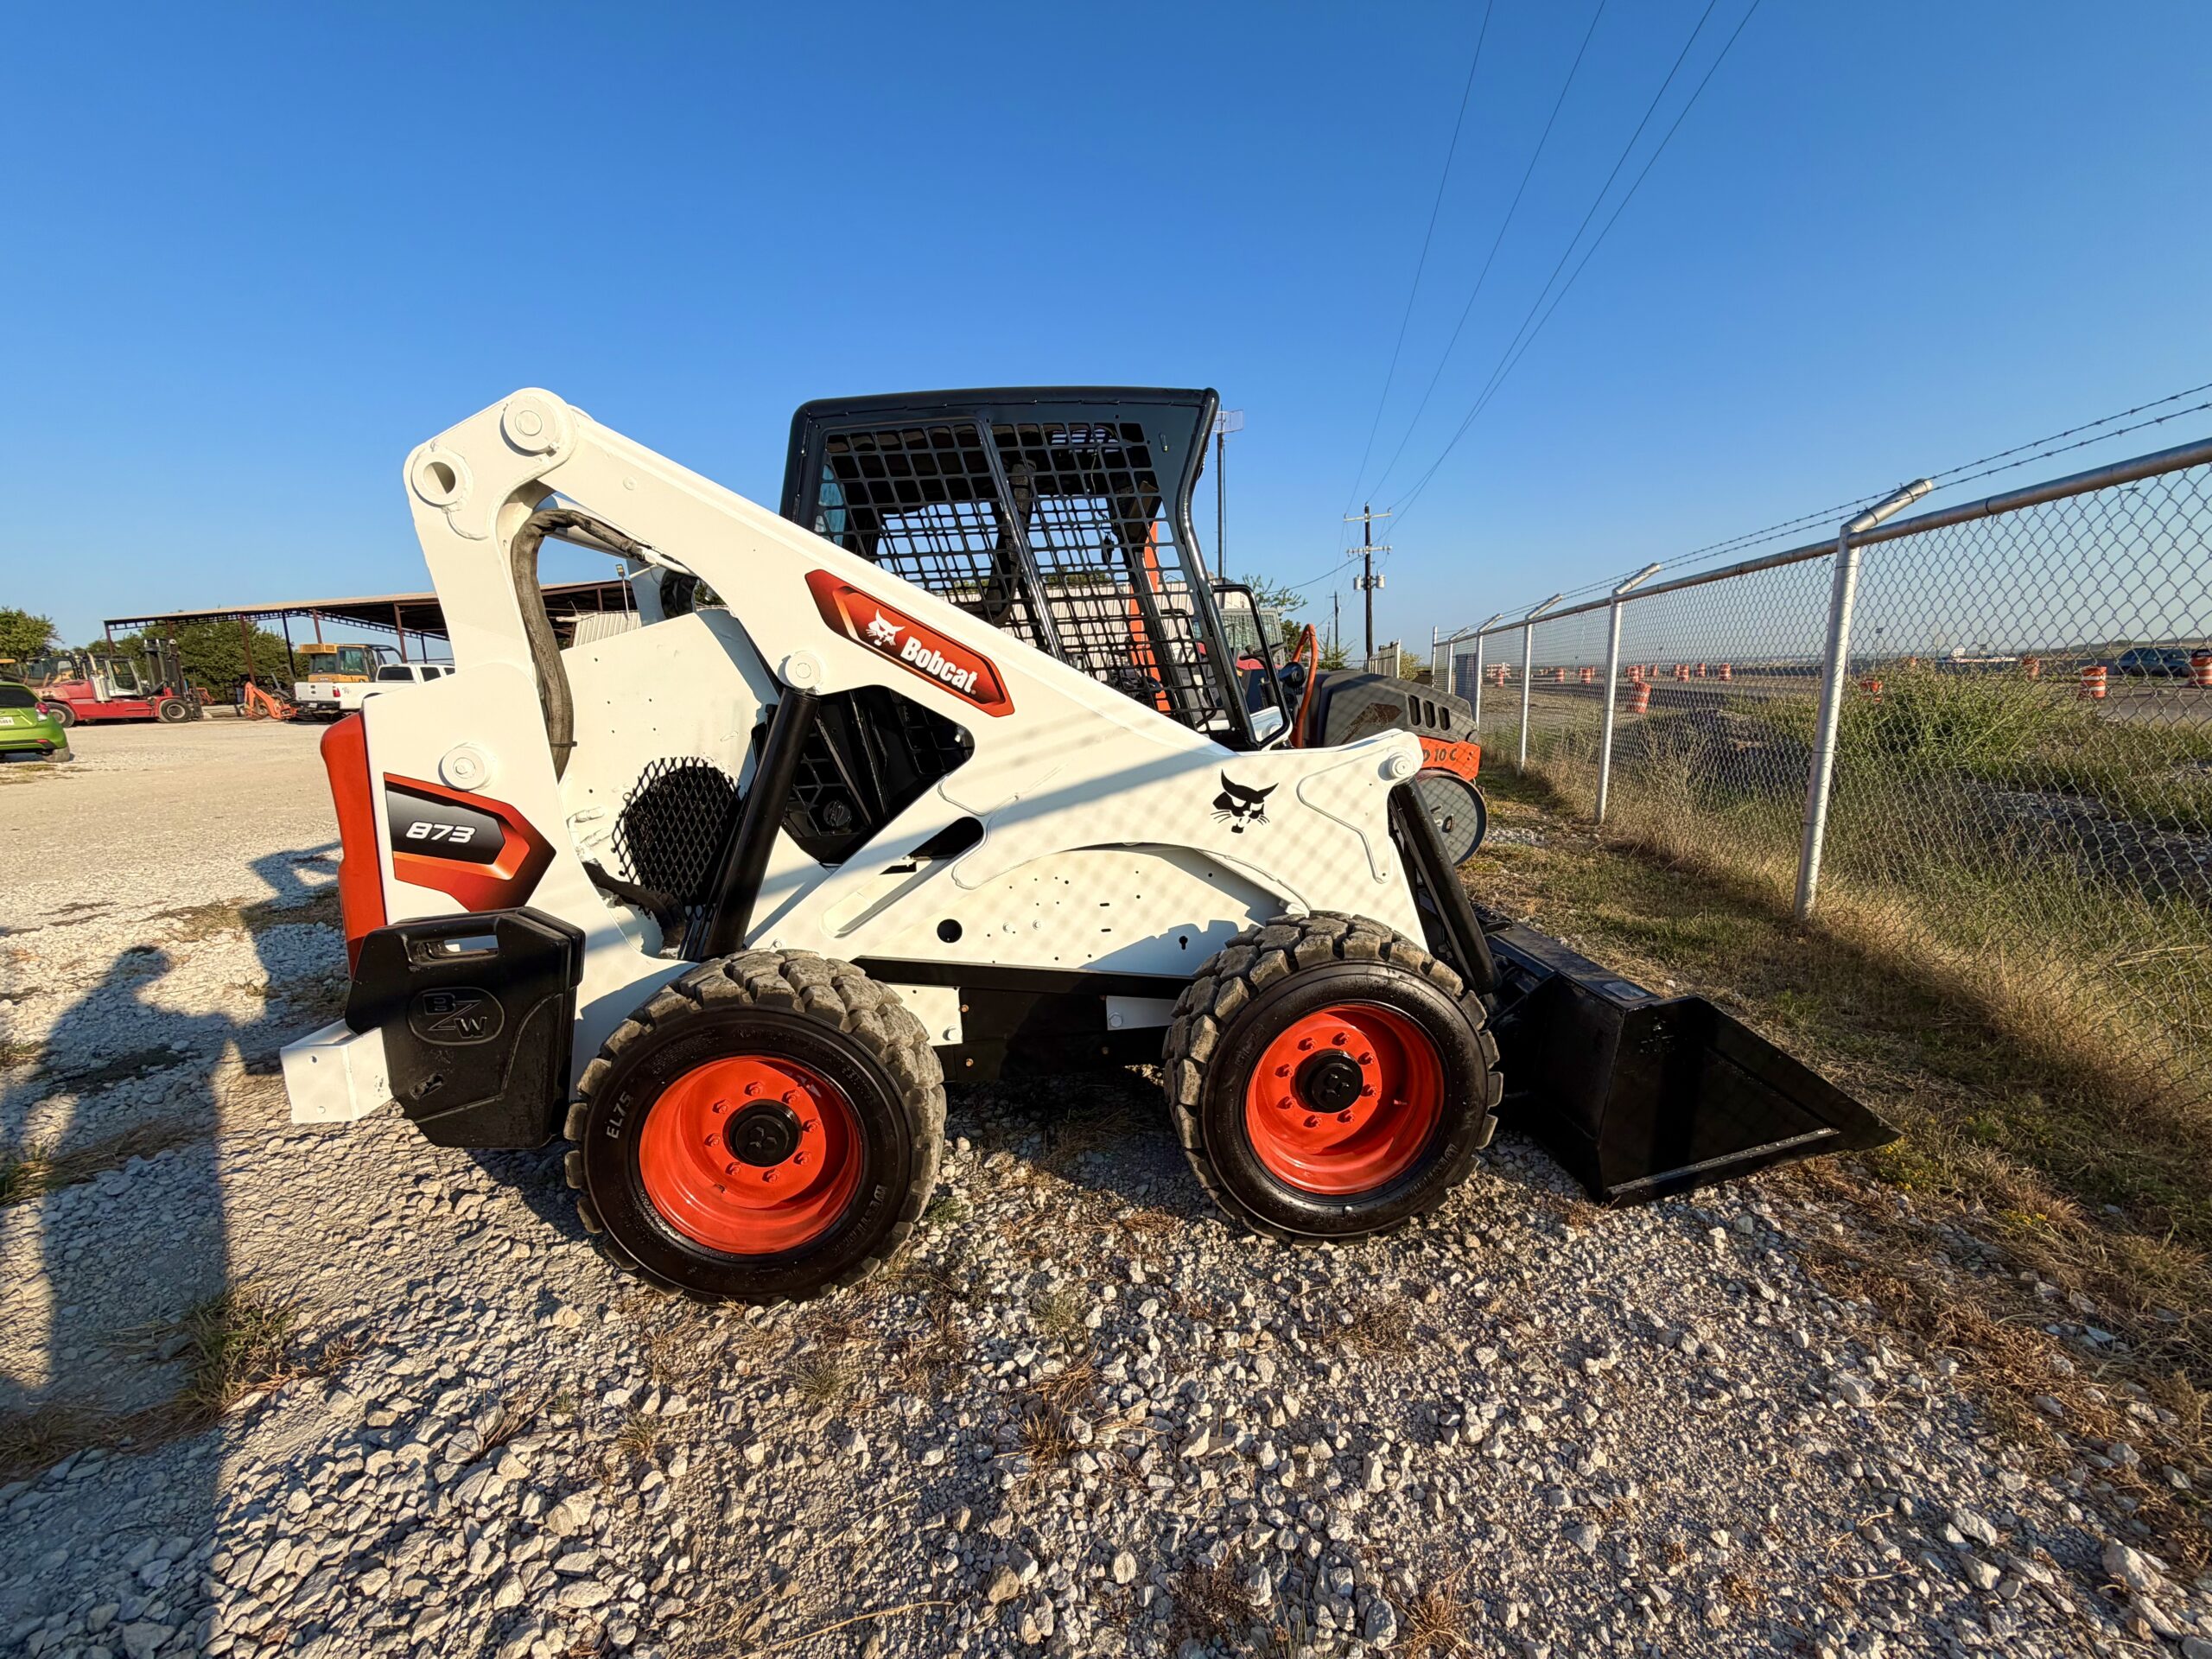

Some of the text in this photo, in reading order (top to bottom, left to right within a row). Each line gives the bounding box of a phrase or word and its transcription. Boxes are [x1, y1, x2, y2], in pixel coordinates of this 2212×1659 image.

[900, 636, 978, 694] Bobcat
[1434, 748, 1447, 762] 10
[1449, 747, 1458, 761] C
[406, 822, 476, 843] 873
[606, 1090, 632, 1140] EL75
